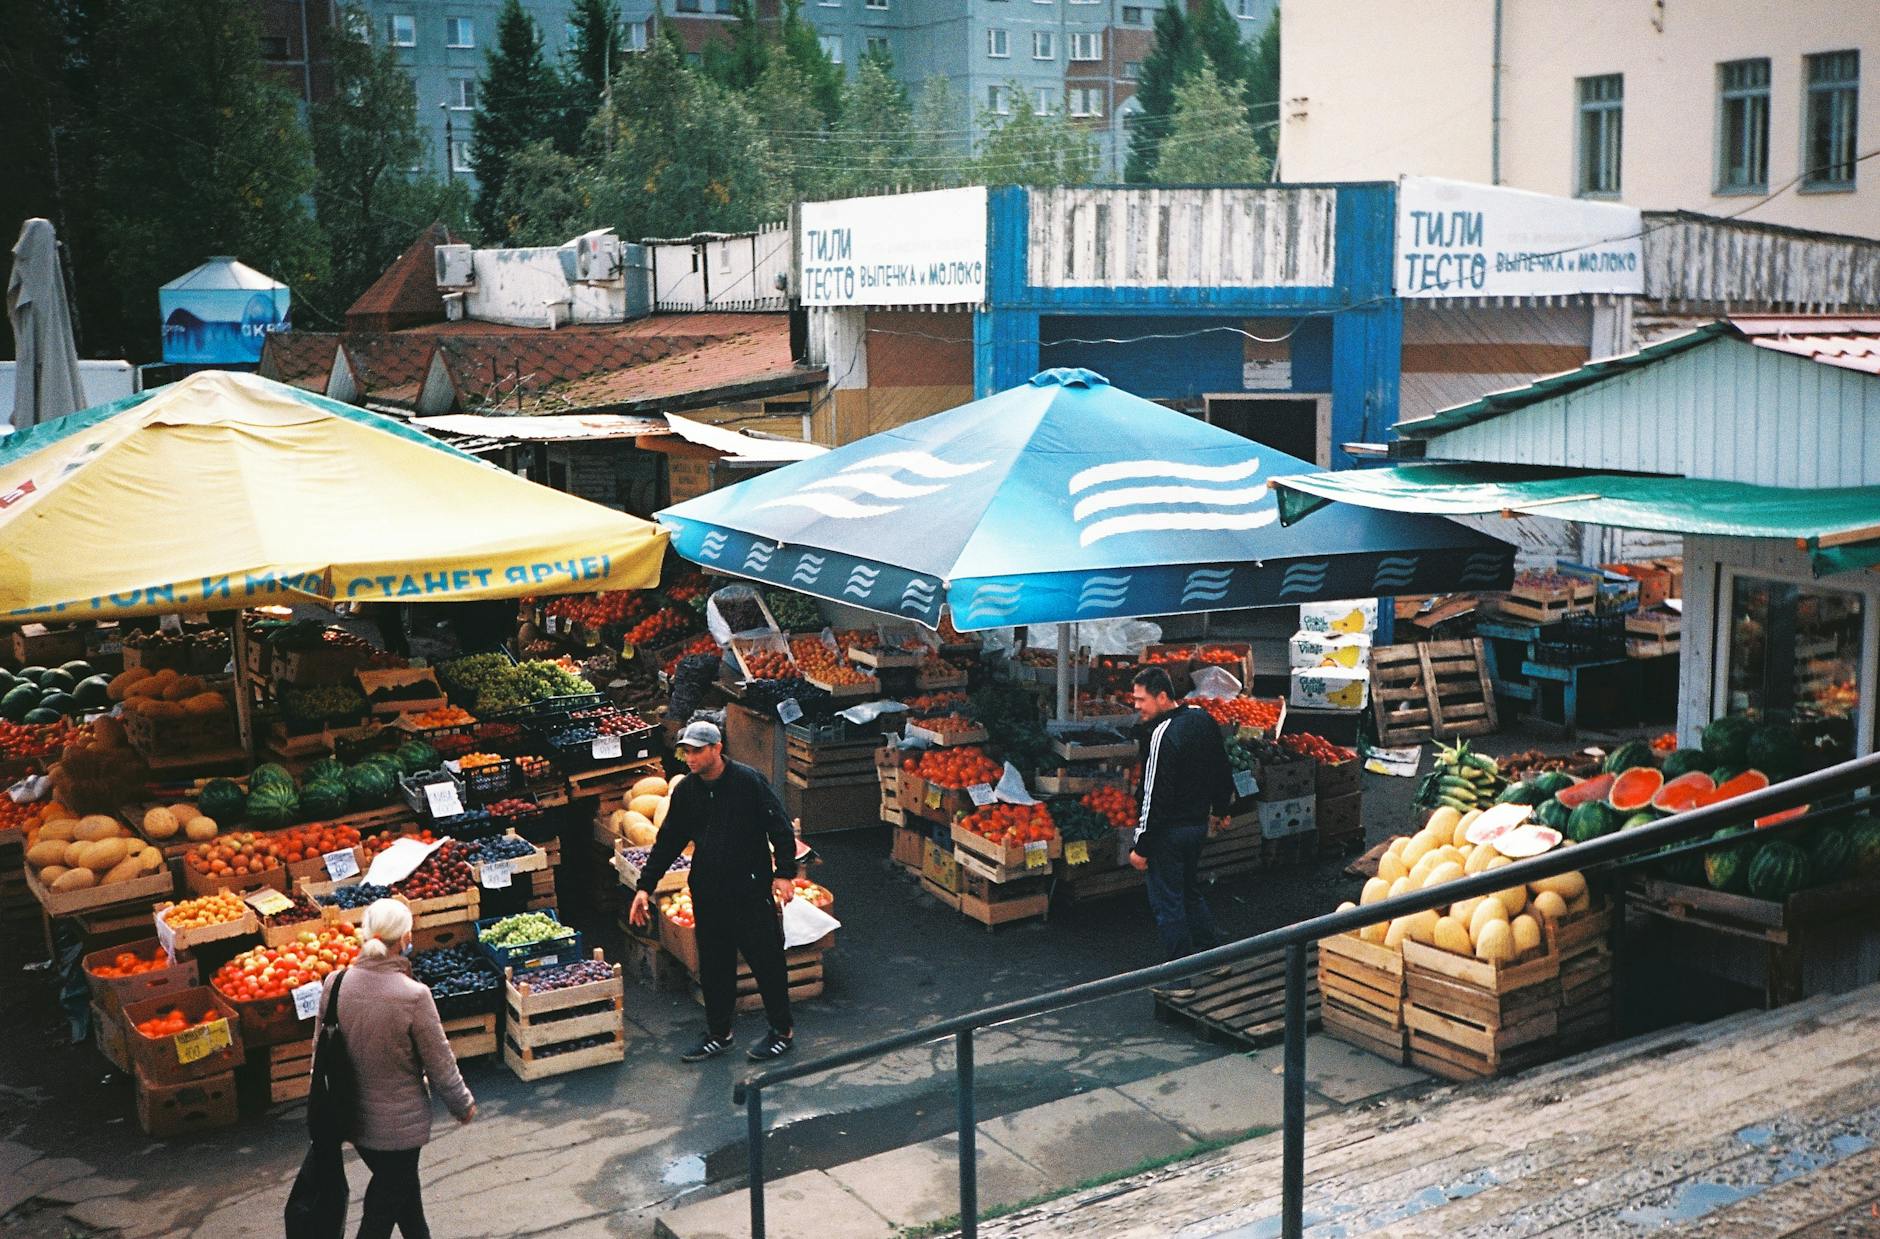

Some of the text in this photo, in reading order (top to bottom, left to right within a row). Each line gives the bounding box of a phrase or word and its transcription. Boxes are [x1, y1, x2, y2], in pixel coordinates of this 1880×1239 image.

[807, 228, 852, 262] ТИЛИ
[1410, 210, 1483, 248] ТИЛИ
[860, 264, 916, 288] ВЫПЕЧКА
[929, 260, 982, 286] МОЛОКО
[1404, 253, 1487, 290] ТЕСТО
[1496, 252, 1564, 273] ВЫПЕЧКА
[1579, 252, 1636, 272] МОЛОКО
[805, 266, 855, 300] ТЕСТО
[347, 568, 493, 599] СТАНЕТ
[505, 554, 611, 586] ЯРЧЕ!
